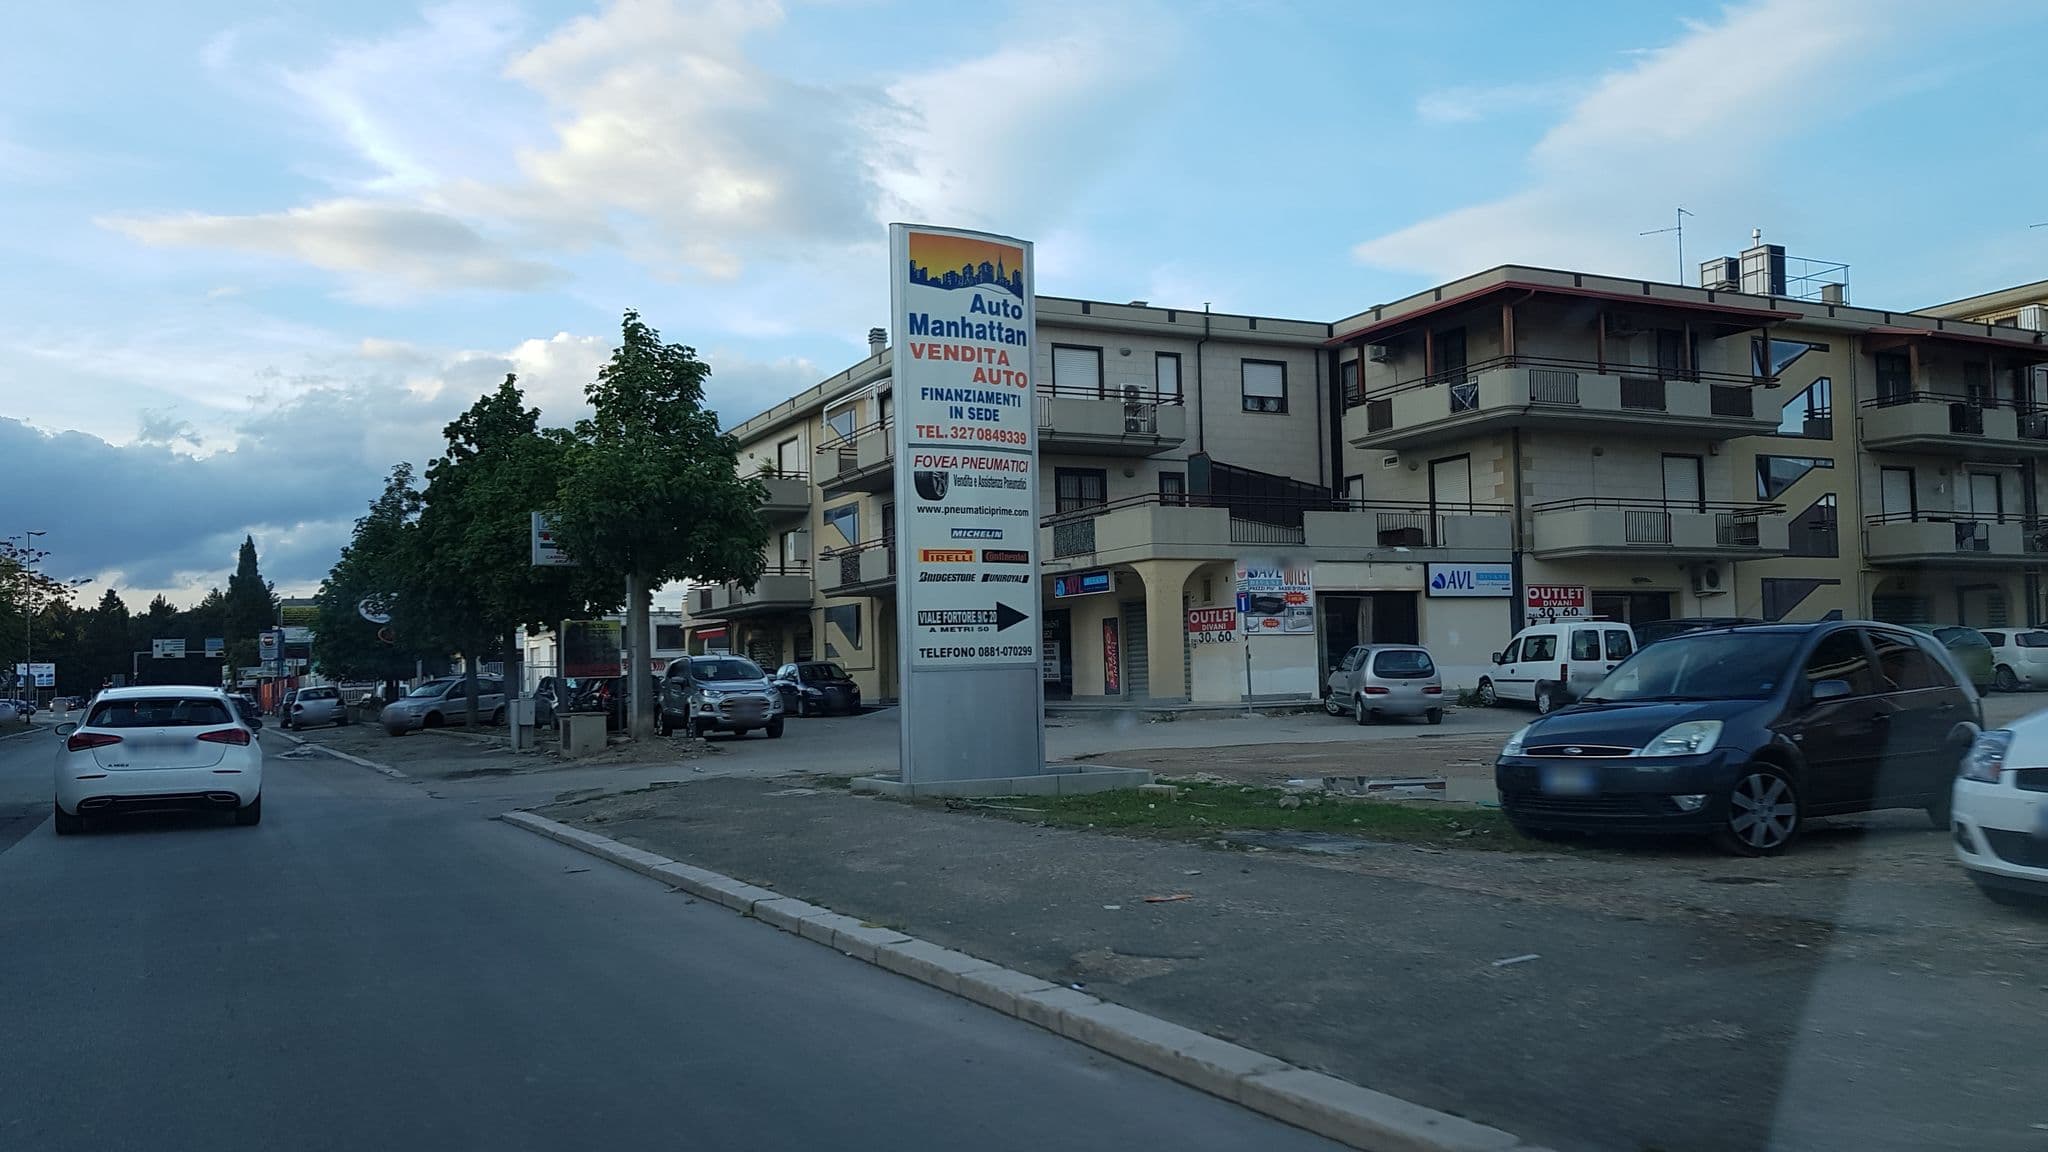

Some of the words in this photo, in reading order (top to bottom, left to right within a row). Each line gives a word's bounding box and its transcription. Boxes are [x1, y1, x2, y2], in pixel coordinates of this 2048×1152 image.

[970, 294, 1023, 320] Auto
[909, 313, 1027, 346] Manhattan
[910, 343, 1010, 366] VENDITA
[973, 367, 1028, 388] AUTO
[921, 387, 1021, 407] FINANZIAMENTI
[949, 406, 963, 419] IN
[968, 407, 1000, 422] SEDE
[916, 425, 947, 439] TEL.
[914, 455, 958, 469] FOVEA
[961, 457, 1028, 473] PNEUMATICI
[953, 474, 973, 487] Vendita
[978, 475, 1003, 488] Assistenza
[916, 505, 1029, 517] www.pneumaticiprime.com
[952, 530, 1002, 538] MICHELIN
[922, 549, 973, 562] PIRELLI
[985, 551, 1027, 562] Continental
[918, 571, 976, 582] BRIDGESTONE
[989, 574, 1023, 583] UNIROYAL
[1446, 570, 1475, 590] AVL
[1529, 587, 1583, 600] OUTLET
[918, 611, 942, 624] VIALE
[943, 611, 976, 624] FORTORE
[1190, 609, 1236, 624] OUTLET
[1538, 607, 1554, 618] 30
[1562, 607, 1579, 617] 60
[1201, 623, 1227, 631] DIVANI
[1198, 632, 1212, 643] 30
[1218, 631, 1232, 642] 60
[919, 647, 976, 658] TELEFONO
[978, 646, 1033, 657] 0881-070299
